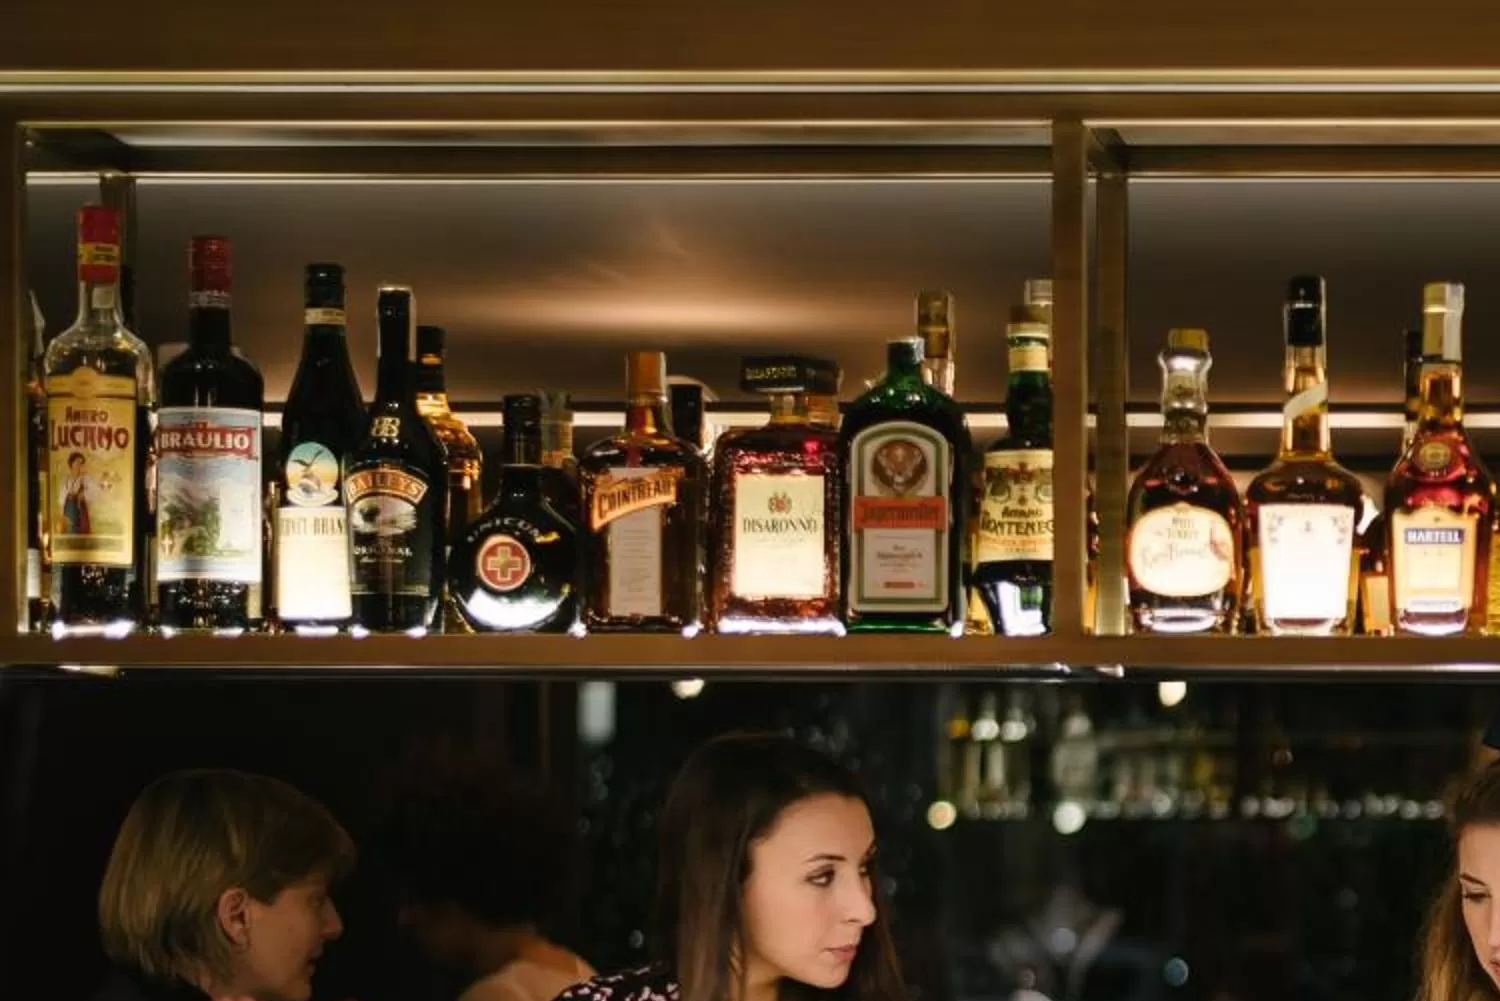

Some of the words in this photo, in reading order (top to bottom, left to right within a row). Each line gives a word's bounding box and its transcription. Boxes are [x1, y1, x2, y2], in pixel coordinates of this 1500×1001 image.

[160, 430, 250, 449] BRAULIO
[349, 470, 423, 497] BAILEYS
[742, 517, 817, 534] DISARONNO
